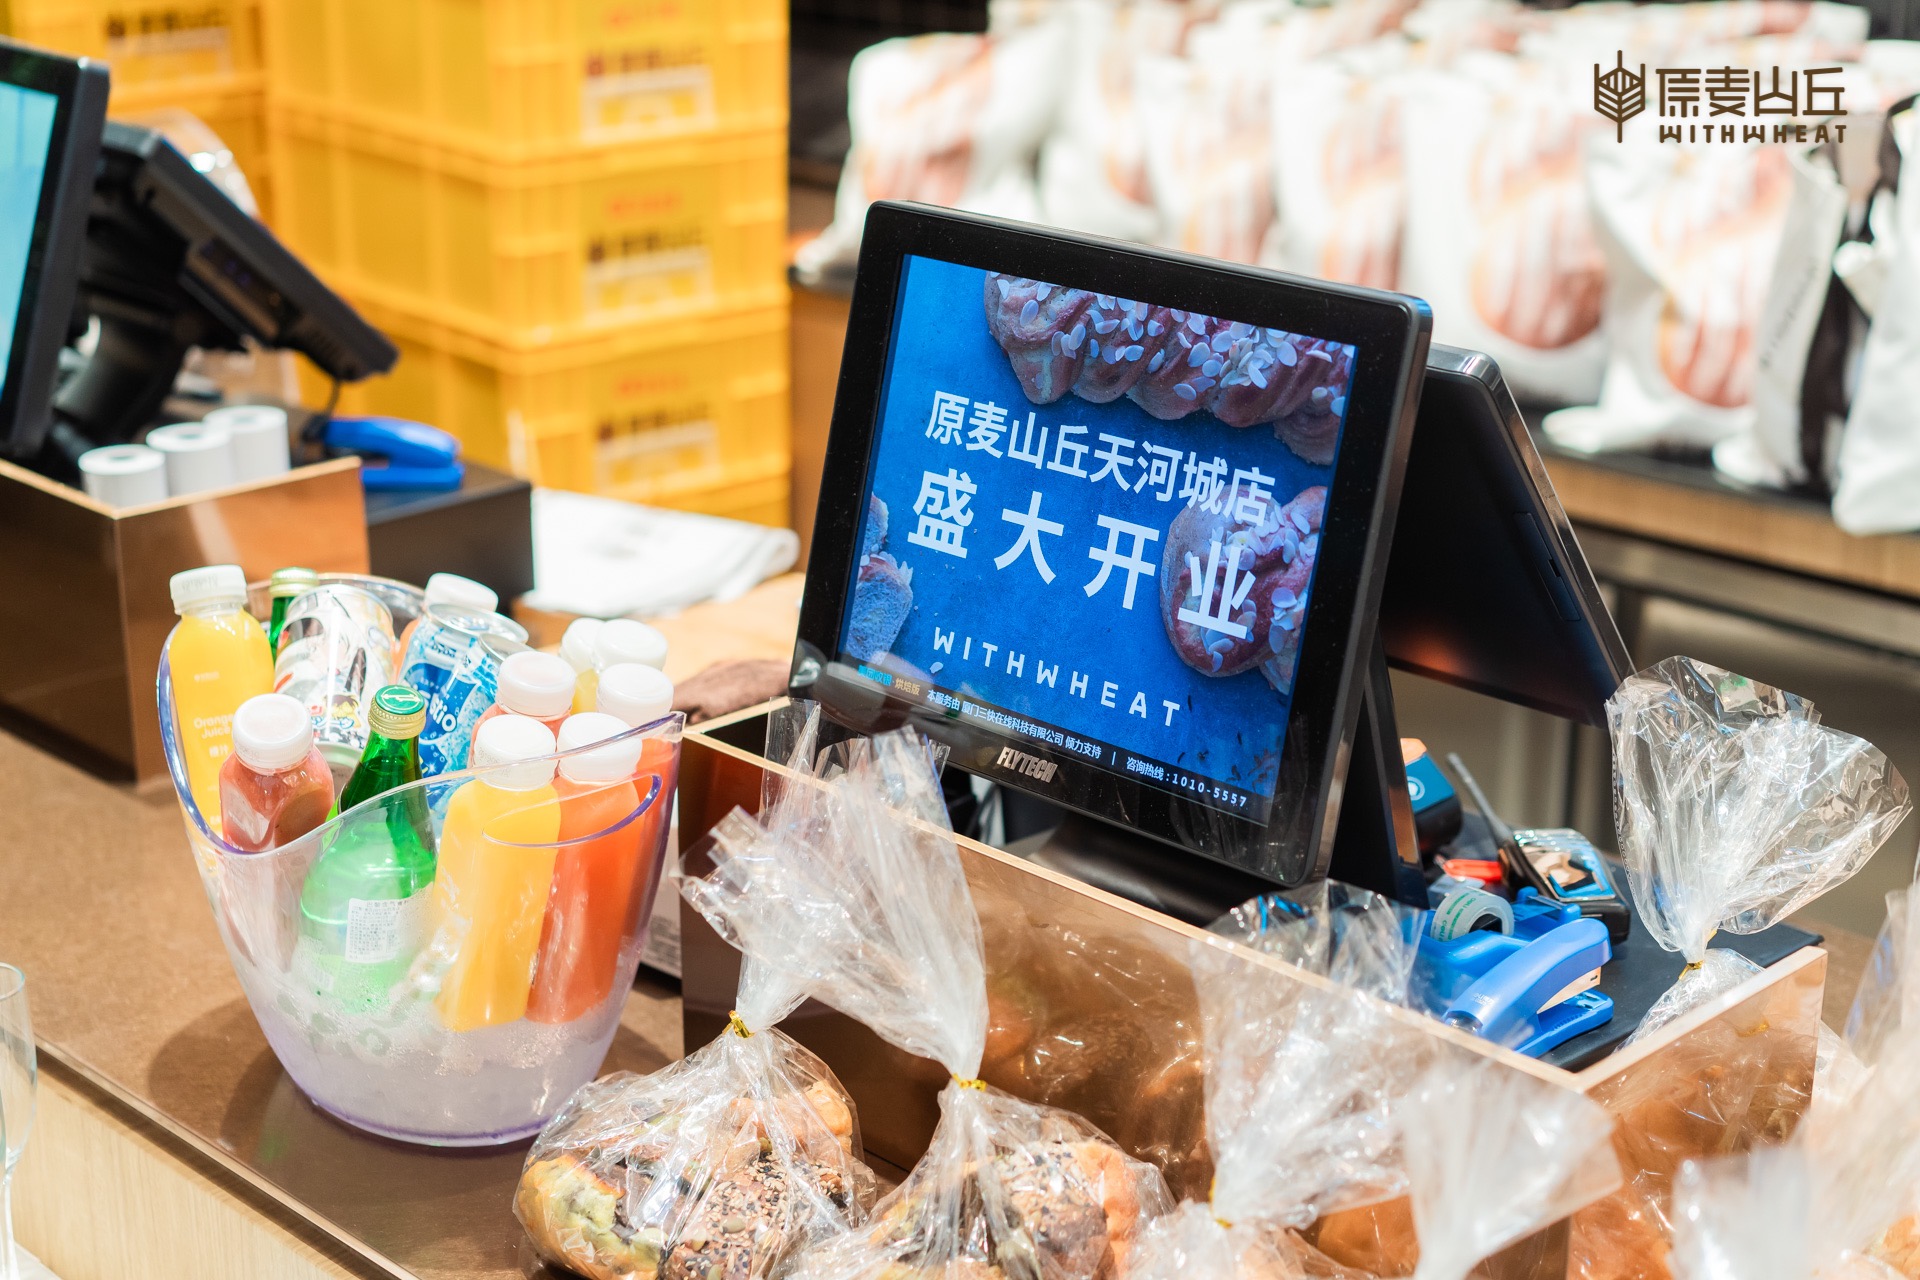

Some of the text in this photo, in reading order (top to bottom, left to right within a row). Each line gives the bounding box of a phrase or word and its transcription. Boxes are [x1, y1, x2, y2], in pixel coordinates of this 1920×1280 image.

[924, 390, 1276, 527] 原麦山丘天河城店
[907, 467, 1257, 640] 盛大开业
[926, 689, 960, 711] 本服务由
[961, 701, 1064, 747] 厦门三快在线科技有限公司
[1065, 734, 1102, 760] 倾力支持
[932, 626, 1181, 727] WITHWHEAT
[996, 746, 1059, 784] FLYTECH
